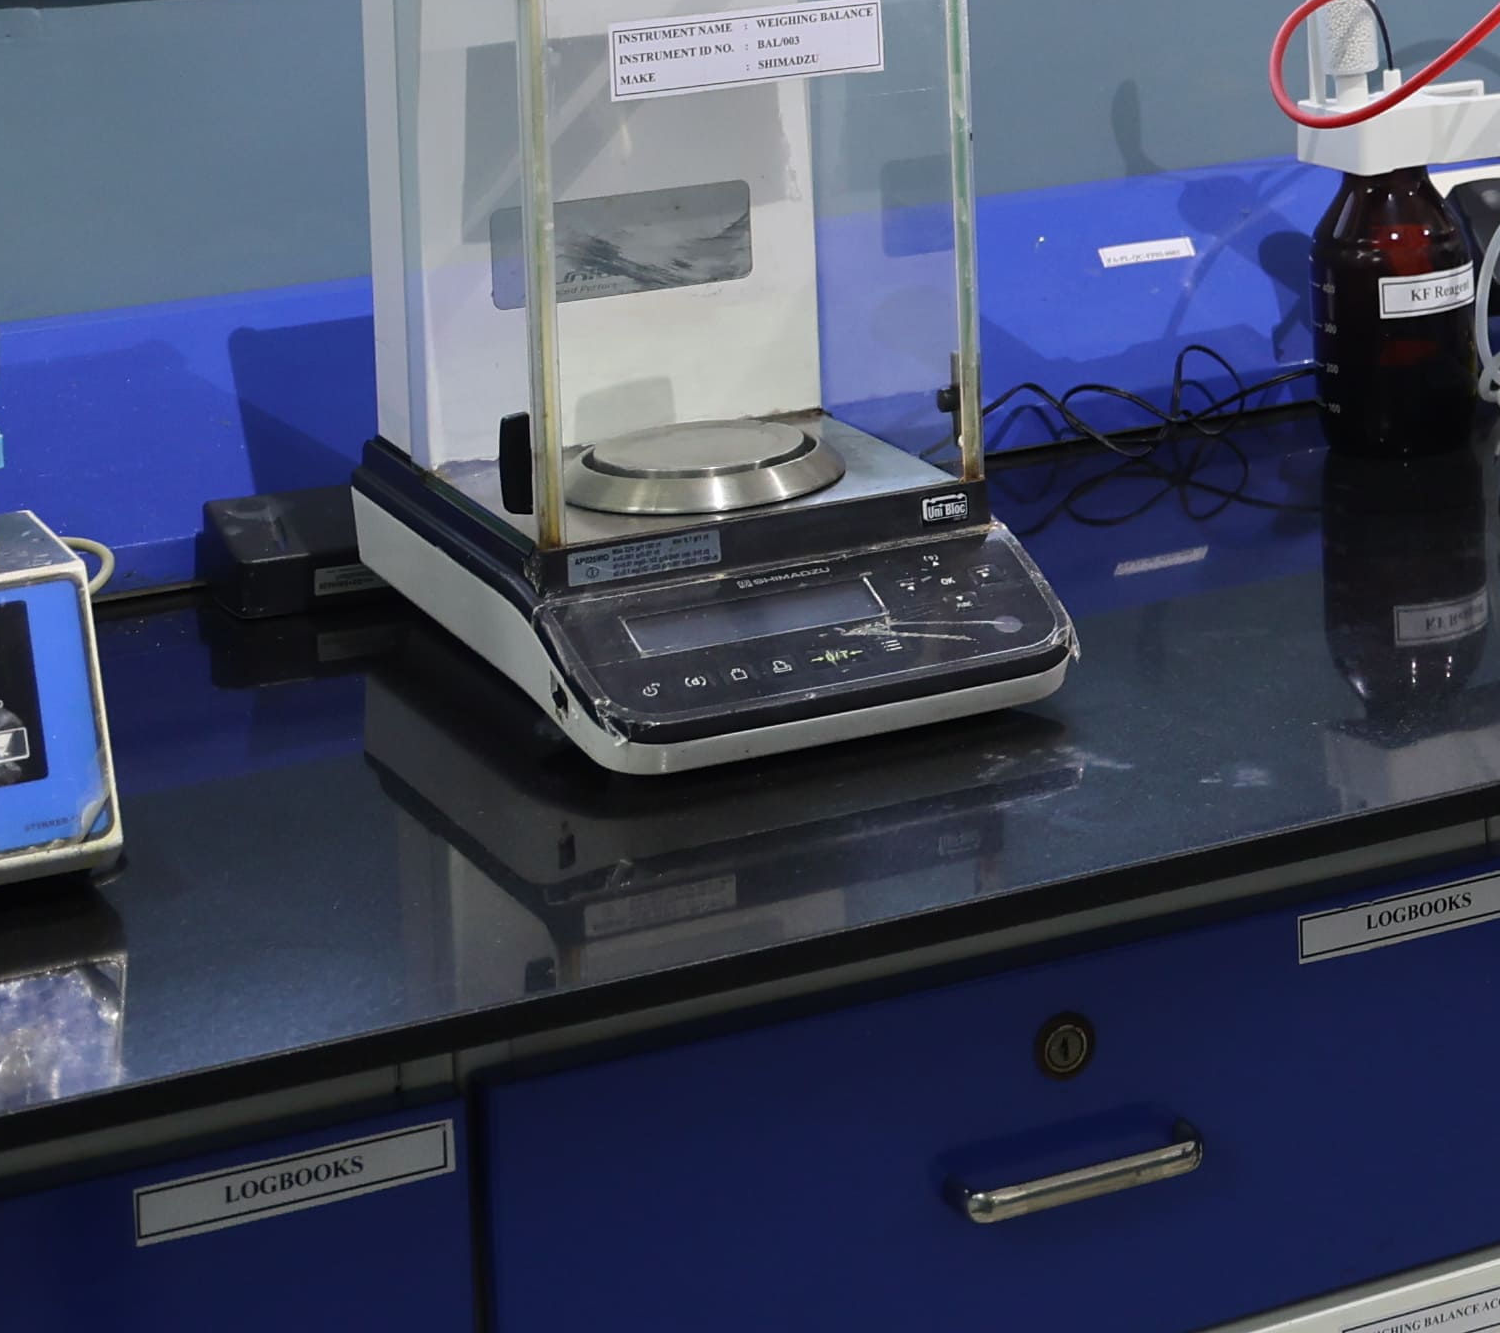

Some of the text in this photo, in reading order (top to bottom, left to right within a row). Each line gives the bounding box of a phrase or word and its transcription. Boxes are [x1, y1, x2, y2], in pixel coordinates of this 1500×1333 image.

[618, 27, 695, 45] INSTRUMENT
[699, 22, 733, 35] NAME
[756, 13, 818, 30] WEIGHING
[820, 7, 874, 23] BALANCE
[619, 48, 698, 66] INSTRUMENT
[700, 46, 713, 56] ID
[715, 43, 735, 55] NO.
[757, 36, 801, 49] BAL/003
[620, 72, 656, 86] MAKE
[757, 53, 820, 71] SHIMADZU
[1411, 288, 1431, 302] KF
[927, 501, 966, 520] Uni Bloc
[753, 566, 831, 585] SHIMADZU
[1366, 891, 1473, 932] LOGBOOKS
[224, 1155, 365, 1205] LOGBOOKS
[1424, 1303, 1480, 1328] BALANCE
